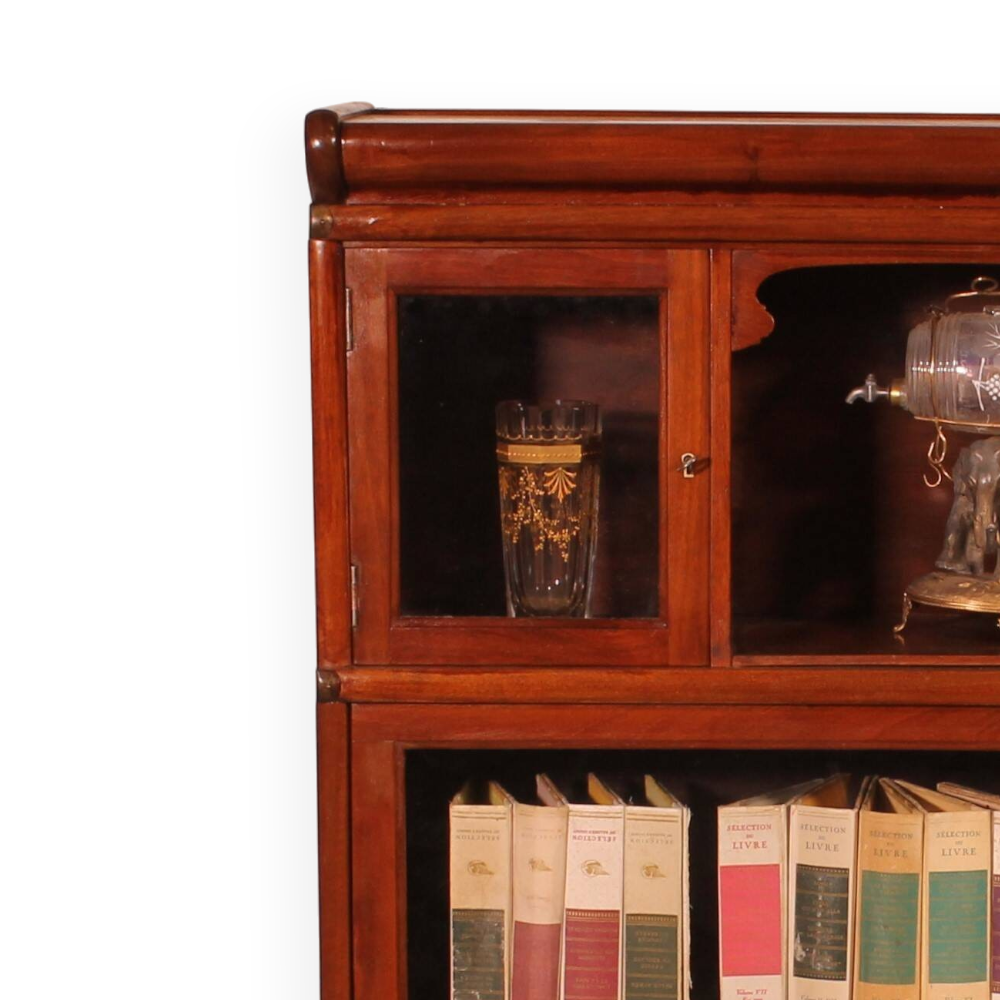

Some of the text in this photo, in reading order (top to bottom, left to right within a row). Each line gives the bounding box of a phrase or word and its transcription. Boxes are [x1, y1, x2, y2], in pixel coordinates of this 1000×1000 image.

[732, 841, 768, 850] LIVRE
[805, 841, 839, 852] LIVRE
[942, 847, 977, 857] LIVRE
